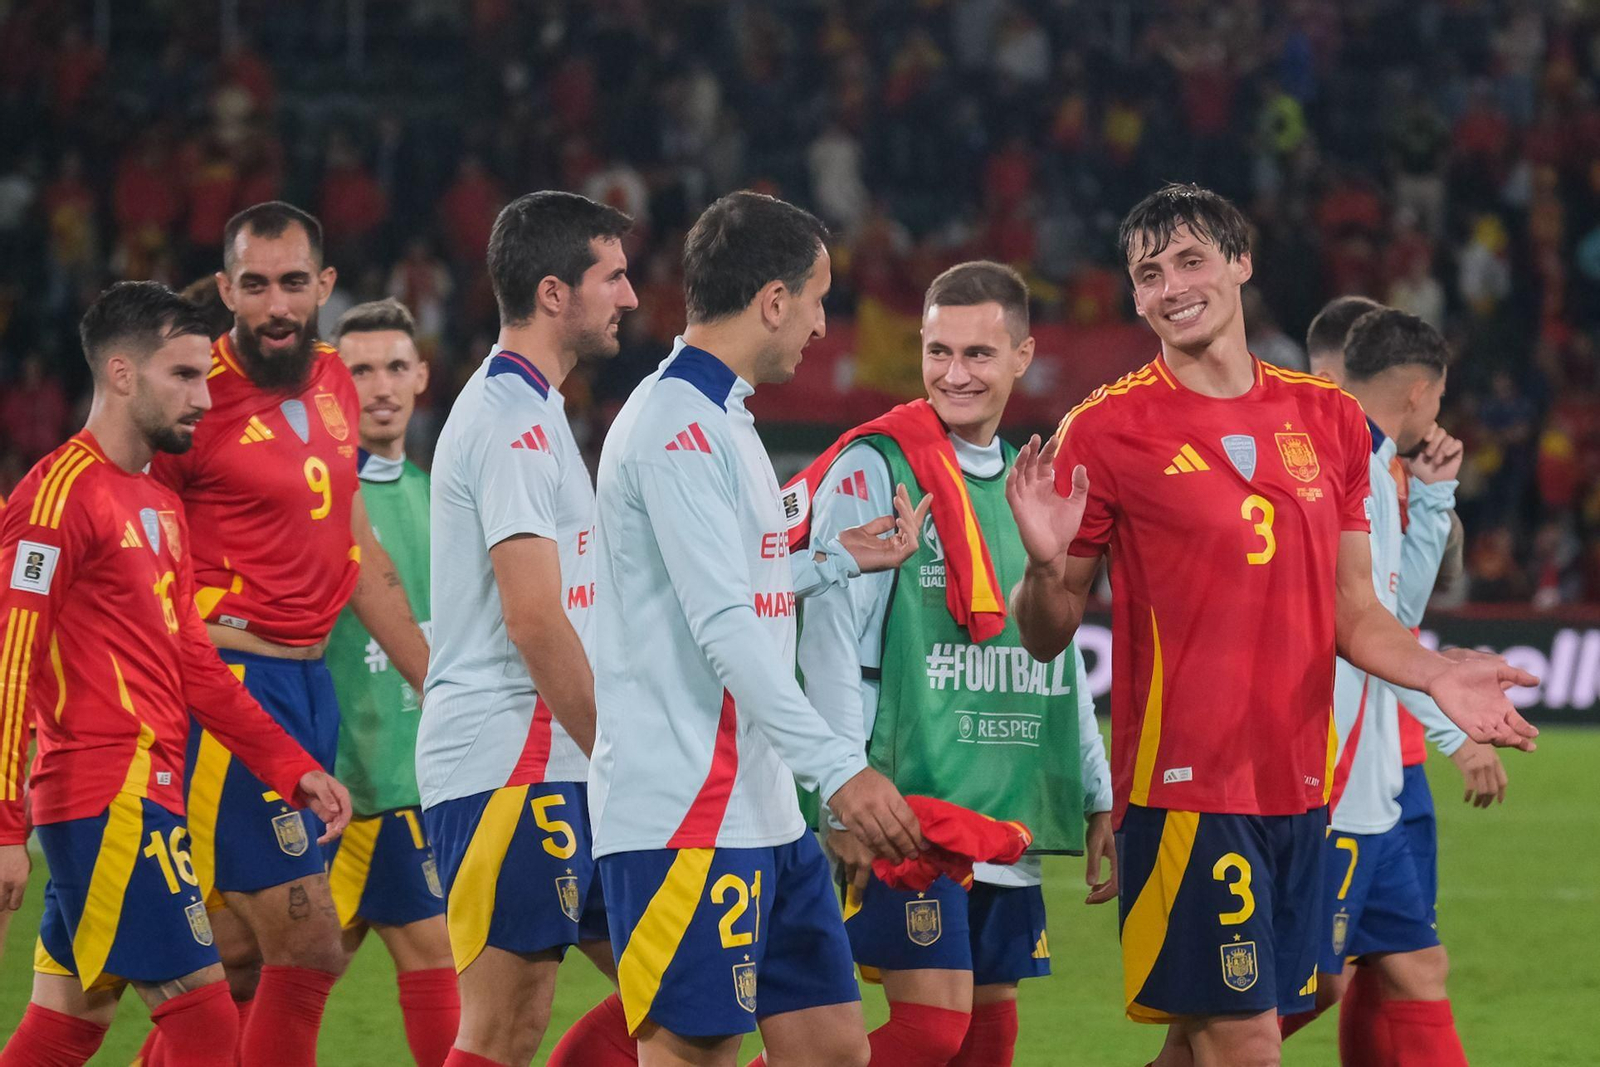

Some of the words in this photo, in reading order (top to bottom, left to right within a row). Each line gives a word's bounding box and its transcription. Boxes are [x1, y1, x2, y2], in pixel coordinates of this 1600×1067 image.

[303, 456, 332, 520] 9
[1240, 494, 1276, 565] 3
[926, 643, 1071, 696] #FOOTBALL
[978, 719, 1042, 740] RESPECT
[144, 826, 199, 894] 16
[530, 794, 577, 860] 5
[1212, 852, 1256, 925] 3
[1336, 837, 1359, 900] 7
[710, 870, 761, 949] 21
